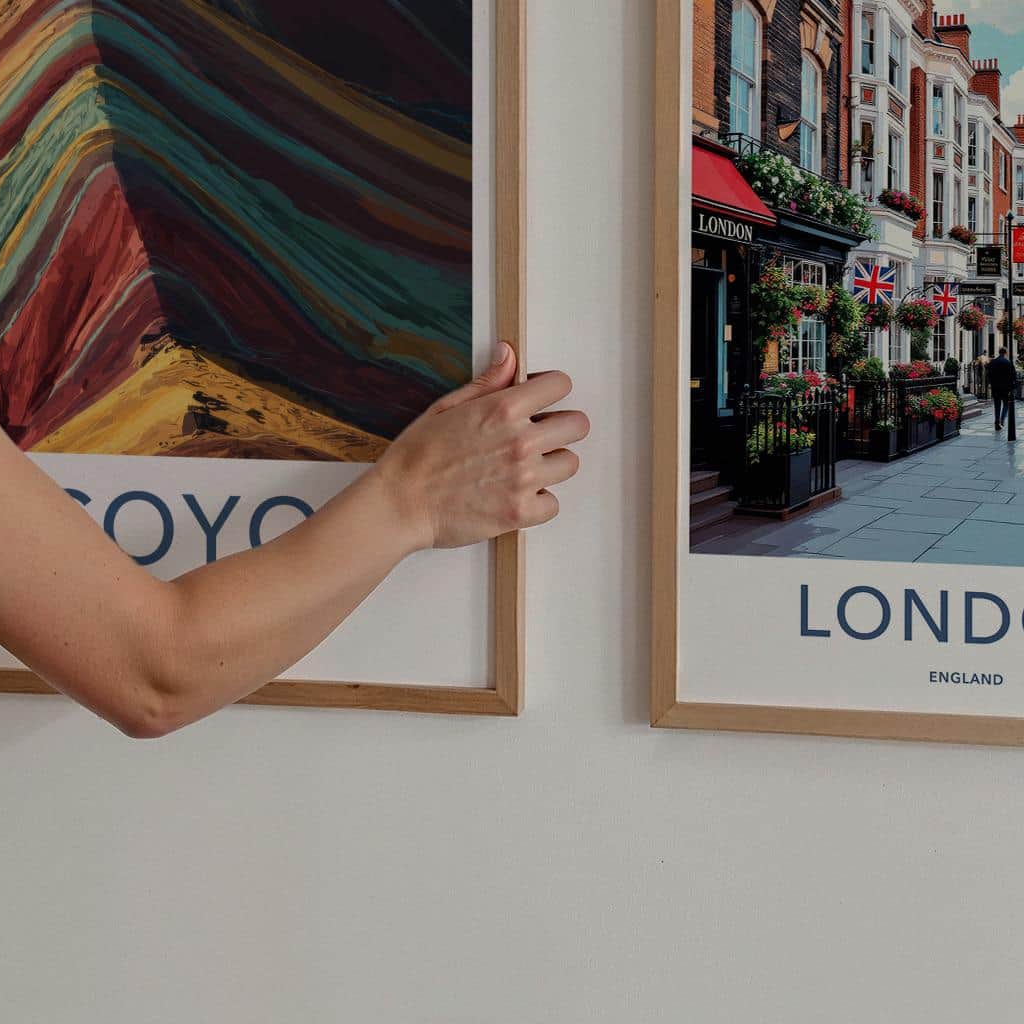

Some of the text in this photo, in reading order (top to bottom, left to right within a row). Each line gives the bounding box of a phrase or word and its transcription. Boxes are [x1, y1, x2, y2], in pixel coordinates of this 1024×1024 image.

[699, 213, 753, 242] LONDON
[800, 584, 1024, 645] LOND
[929, 671, 1004, 686] ENGLAND
